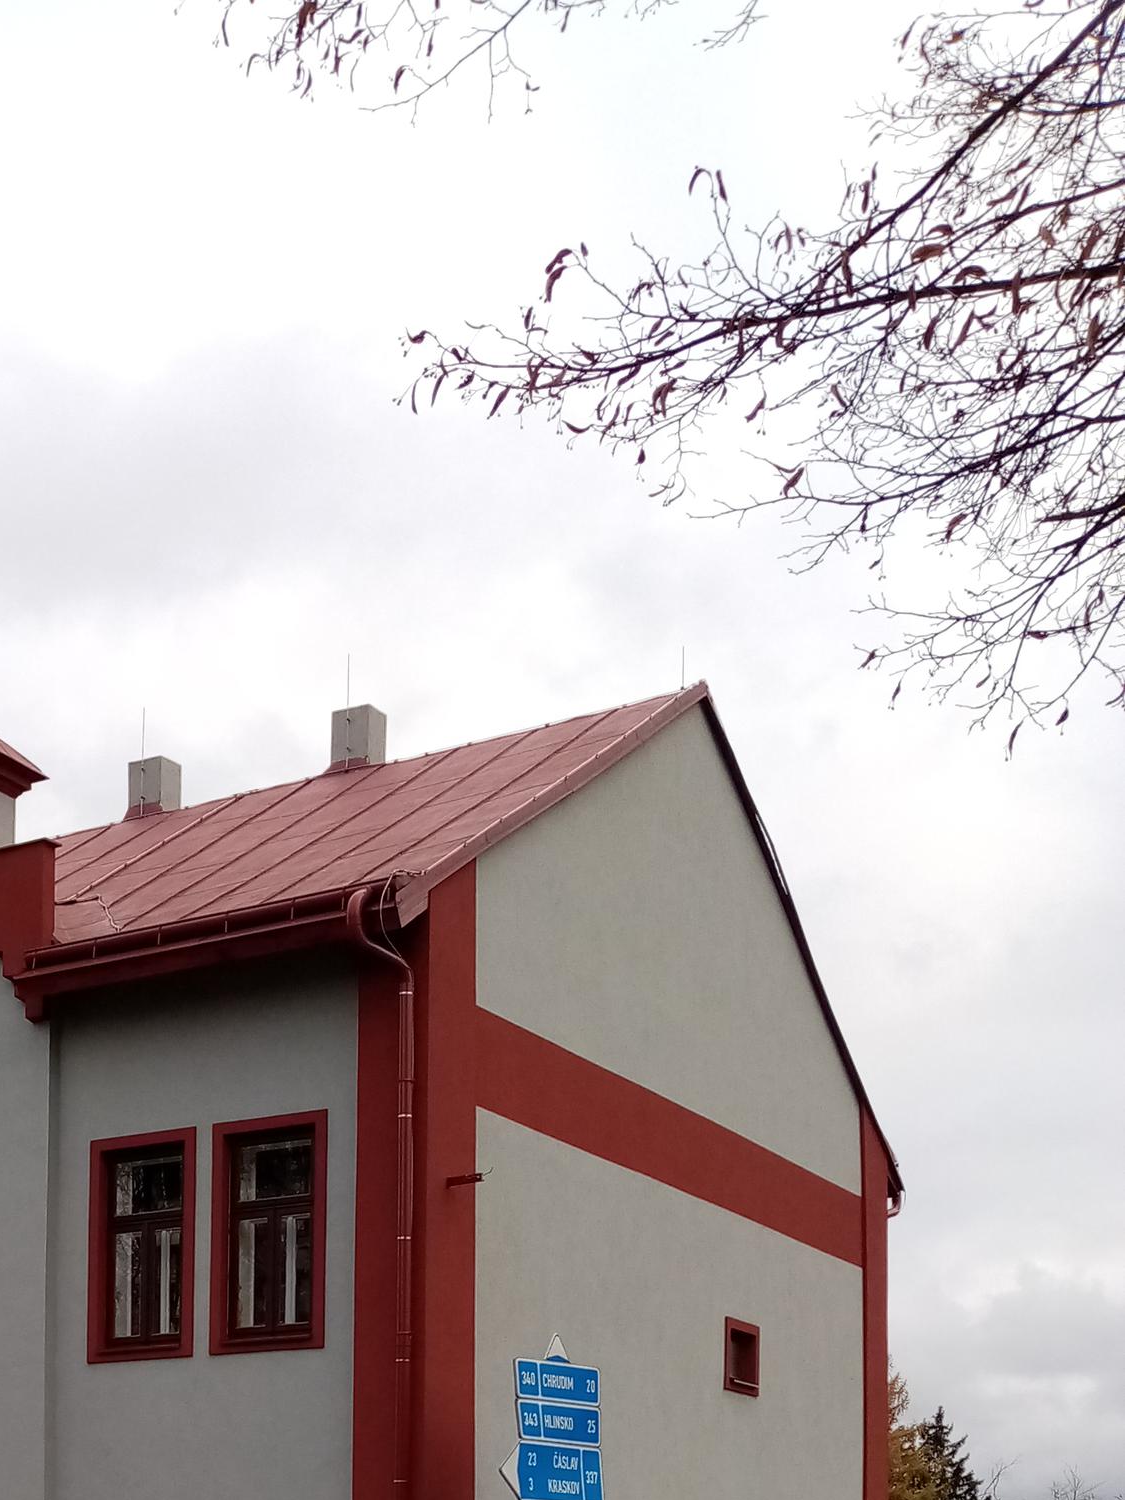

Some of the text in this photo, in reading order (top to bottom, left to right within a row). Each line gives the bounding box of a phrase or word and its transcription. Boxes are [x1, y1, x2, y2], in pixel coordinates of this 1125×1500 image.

[521, 1371, 596, 1393] 340 CHRUDIM 20
[524, 1412, 596, 1434] 343 HLINSKO 25
[527, 1452, 578, 1470] 23 ČÁSLAV
[528, 1478, 580, 1495] 3 KRASKOV
[585, 1471, 598, 1484] 337
